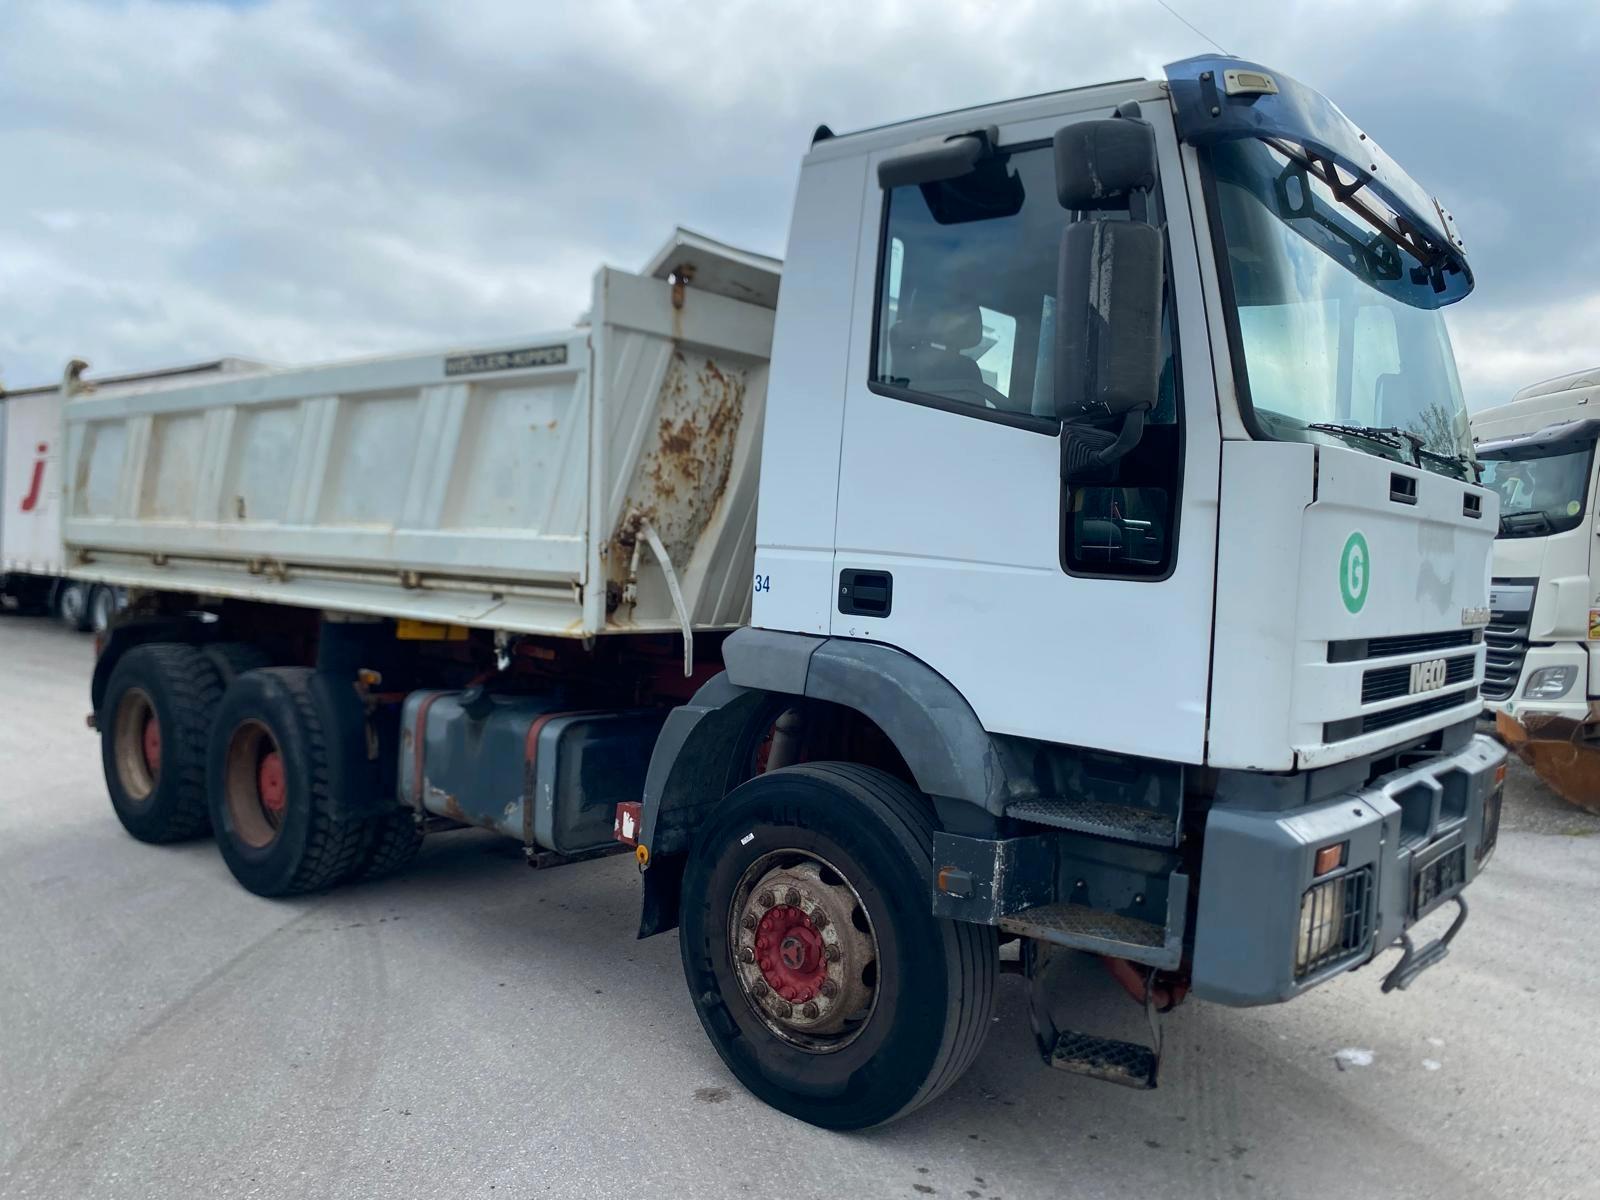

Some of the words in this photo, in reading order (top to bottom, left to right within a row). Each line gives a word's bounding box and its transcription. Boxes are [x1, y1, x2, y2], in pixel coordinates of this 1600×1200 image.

[755, 574, 770, 593] 34
[1347, 544, 1364, 599] G
[1408, 659, 1447, 695] IVECO
